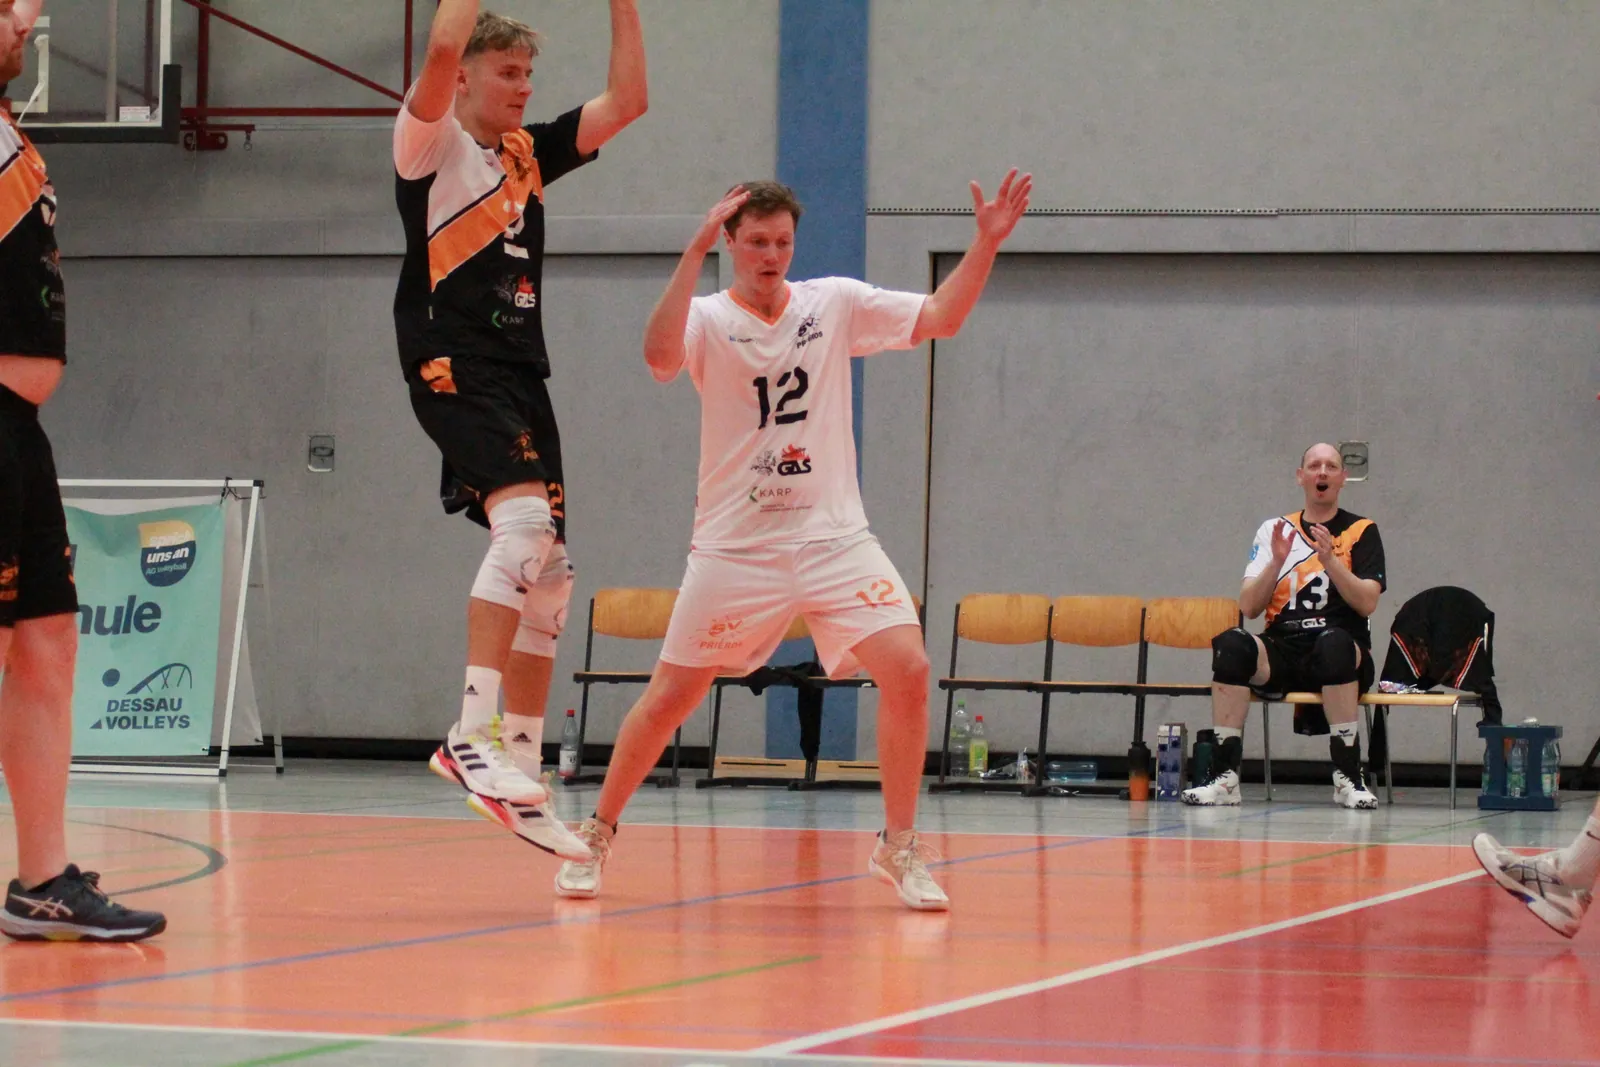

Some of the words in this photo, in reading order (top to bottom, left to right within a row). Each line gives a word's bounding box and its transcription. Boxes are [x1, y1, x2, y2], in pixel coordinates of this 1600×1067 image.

[753, 366, 808, 430] 12
[777, 458, 812, 476] GAS
[760, 487, 792, 498] KARP
[146, 551, 173, 564] uns
[172, 547, 190, 559] an
[856, 579, 902, 608] 12
[1287, 570, 1330, 610] 13
[106, 698, 183, 713] DESSAU
[105, 715, 191, 730] VOLLEYS
